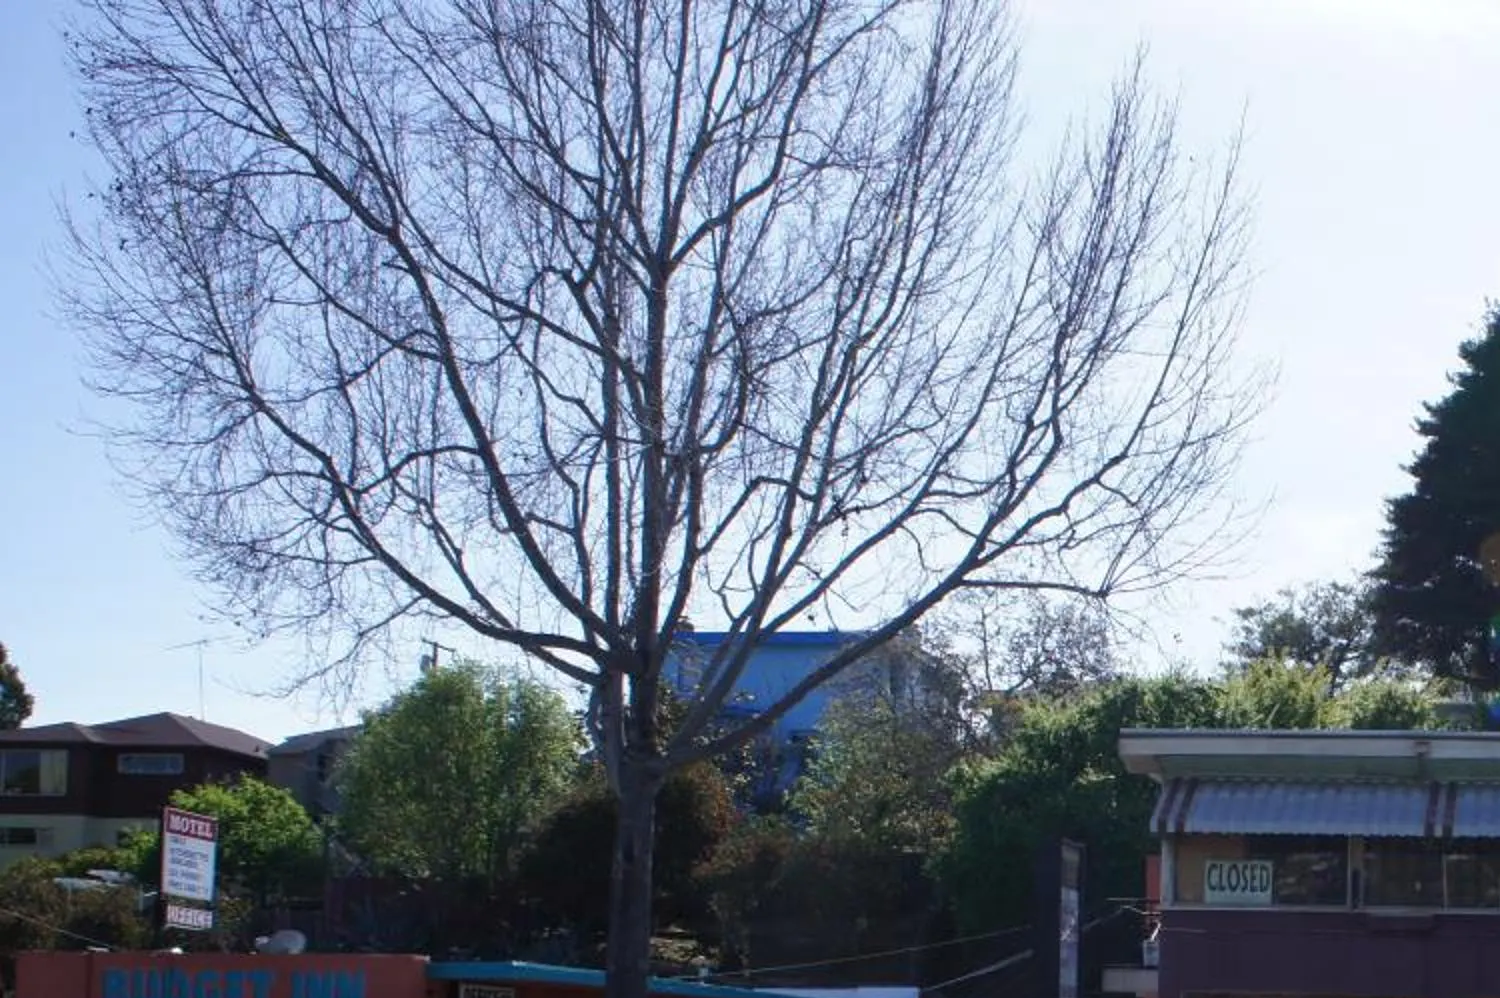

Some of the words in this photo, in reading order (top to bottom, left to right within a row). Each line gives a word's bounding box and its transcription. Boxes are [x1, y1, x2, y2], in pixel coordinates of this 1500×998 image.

[168, 813, 213, 838] MOTEL
[1207, 862, 1271, 893] CLOSED
[167, 904, 213, 929] OFFICE
